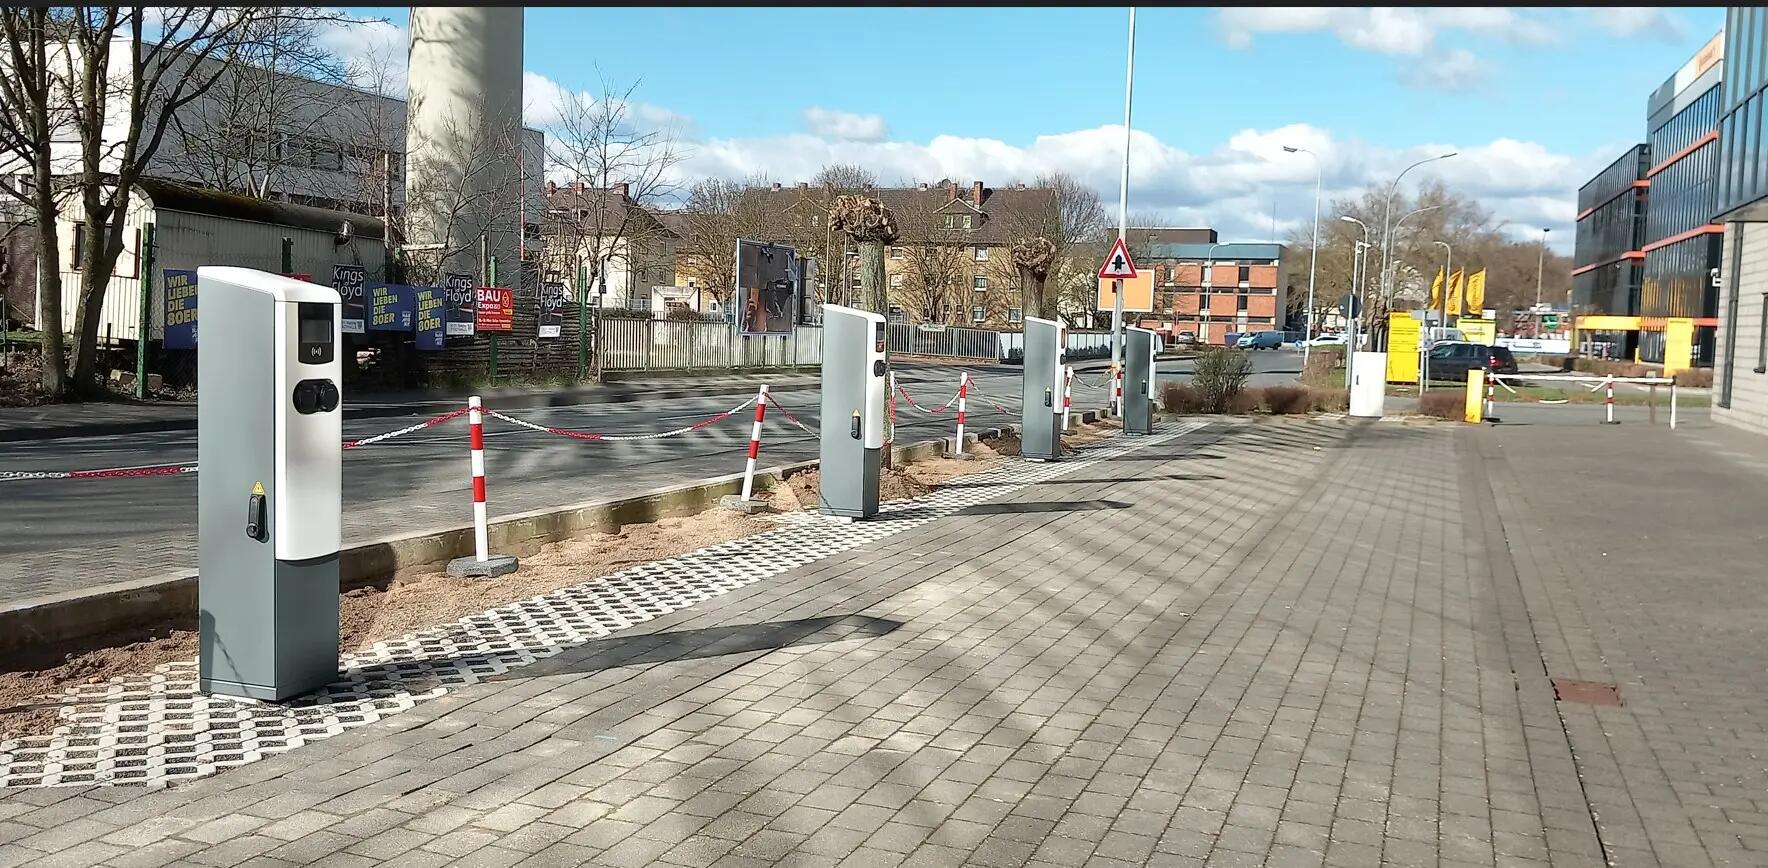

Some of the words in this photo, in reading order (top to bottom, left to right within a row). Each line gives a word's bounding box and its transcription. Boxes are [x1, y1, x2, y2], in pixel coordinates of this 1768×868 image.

[167, 275, 188, 288] WIR
[333, 266, 364, 285] Kings
[445, 275, 472, 291] Kings
[167, 285, 198, 300] LIEBE
[372, 287, 388, 297] WIR
[417, 290, 433, 301] WIR
[445, 288, 472, 305] Floyd
[477, 289, 501, 302] BAU
[541, 285, 563, 298] Kings
[167, 299, 185, 312] DIE
[373, 294, 398, 306] LIEBEN
[418, 298, 443, 311] LIEBEN
[540, 295, 562, 311] Floyd
[373, 305, 386, 315] DIE
[418, 310, 431, 321] DIE
